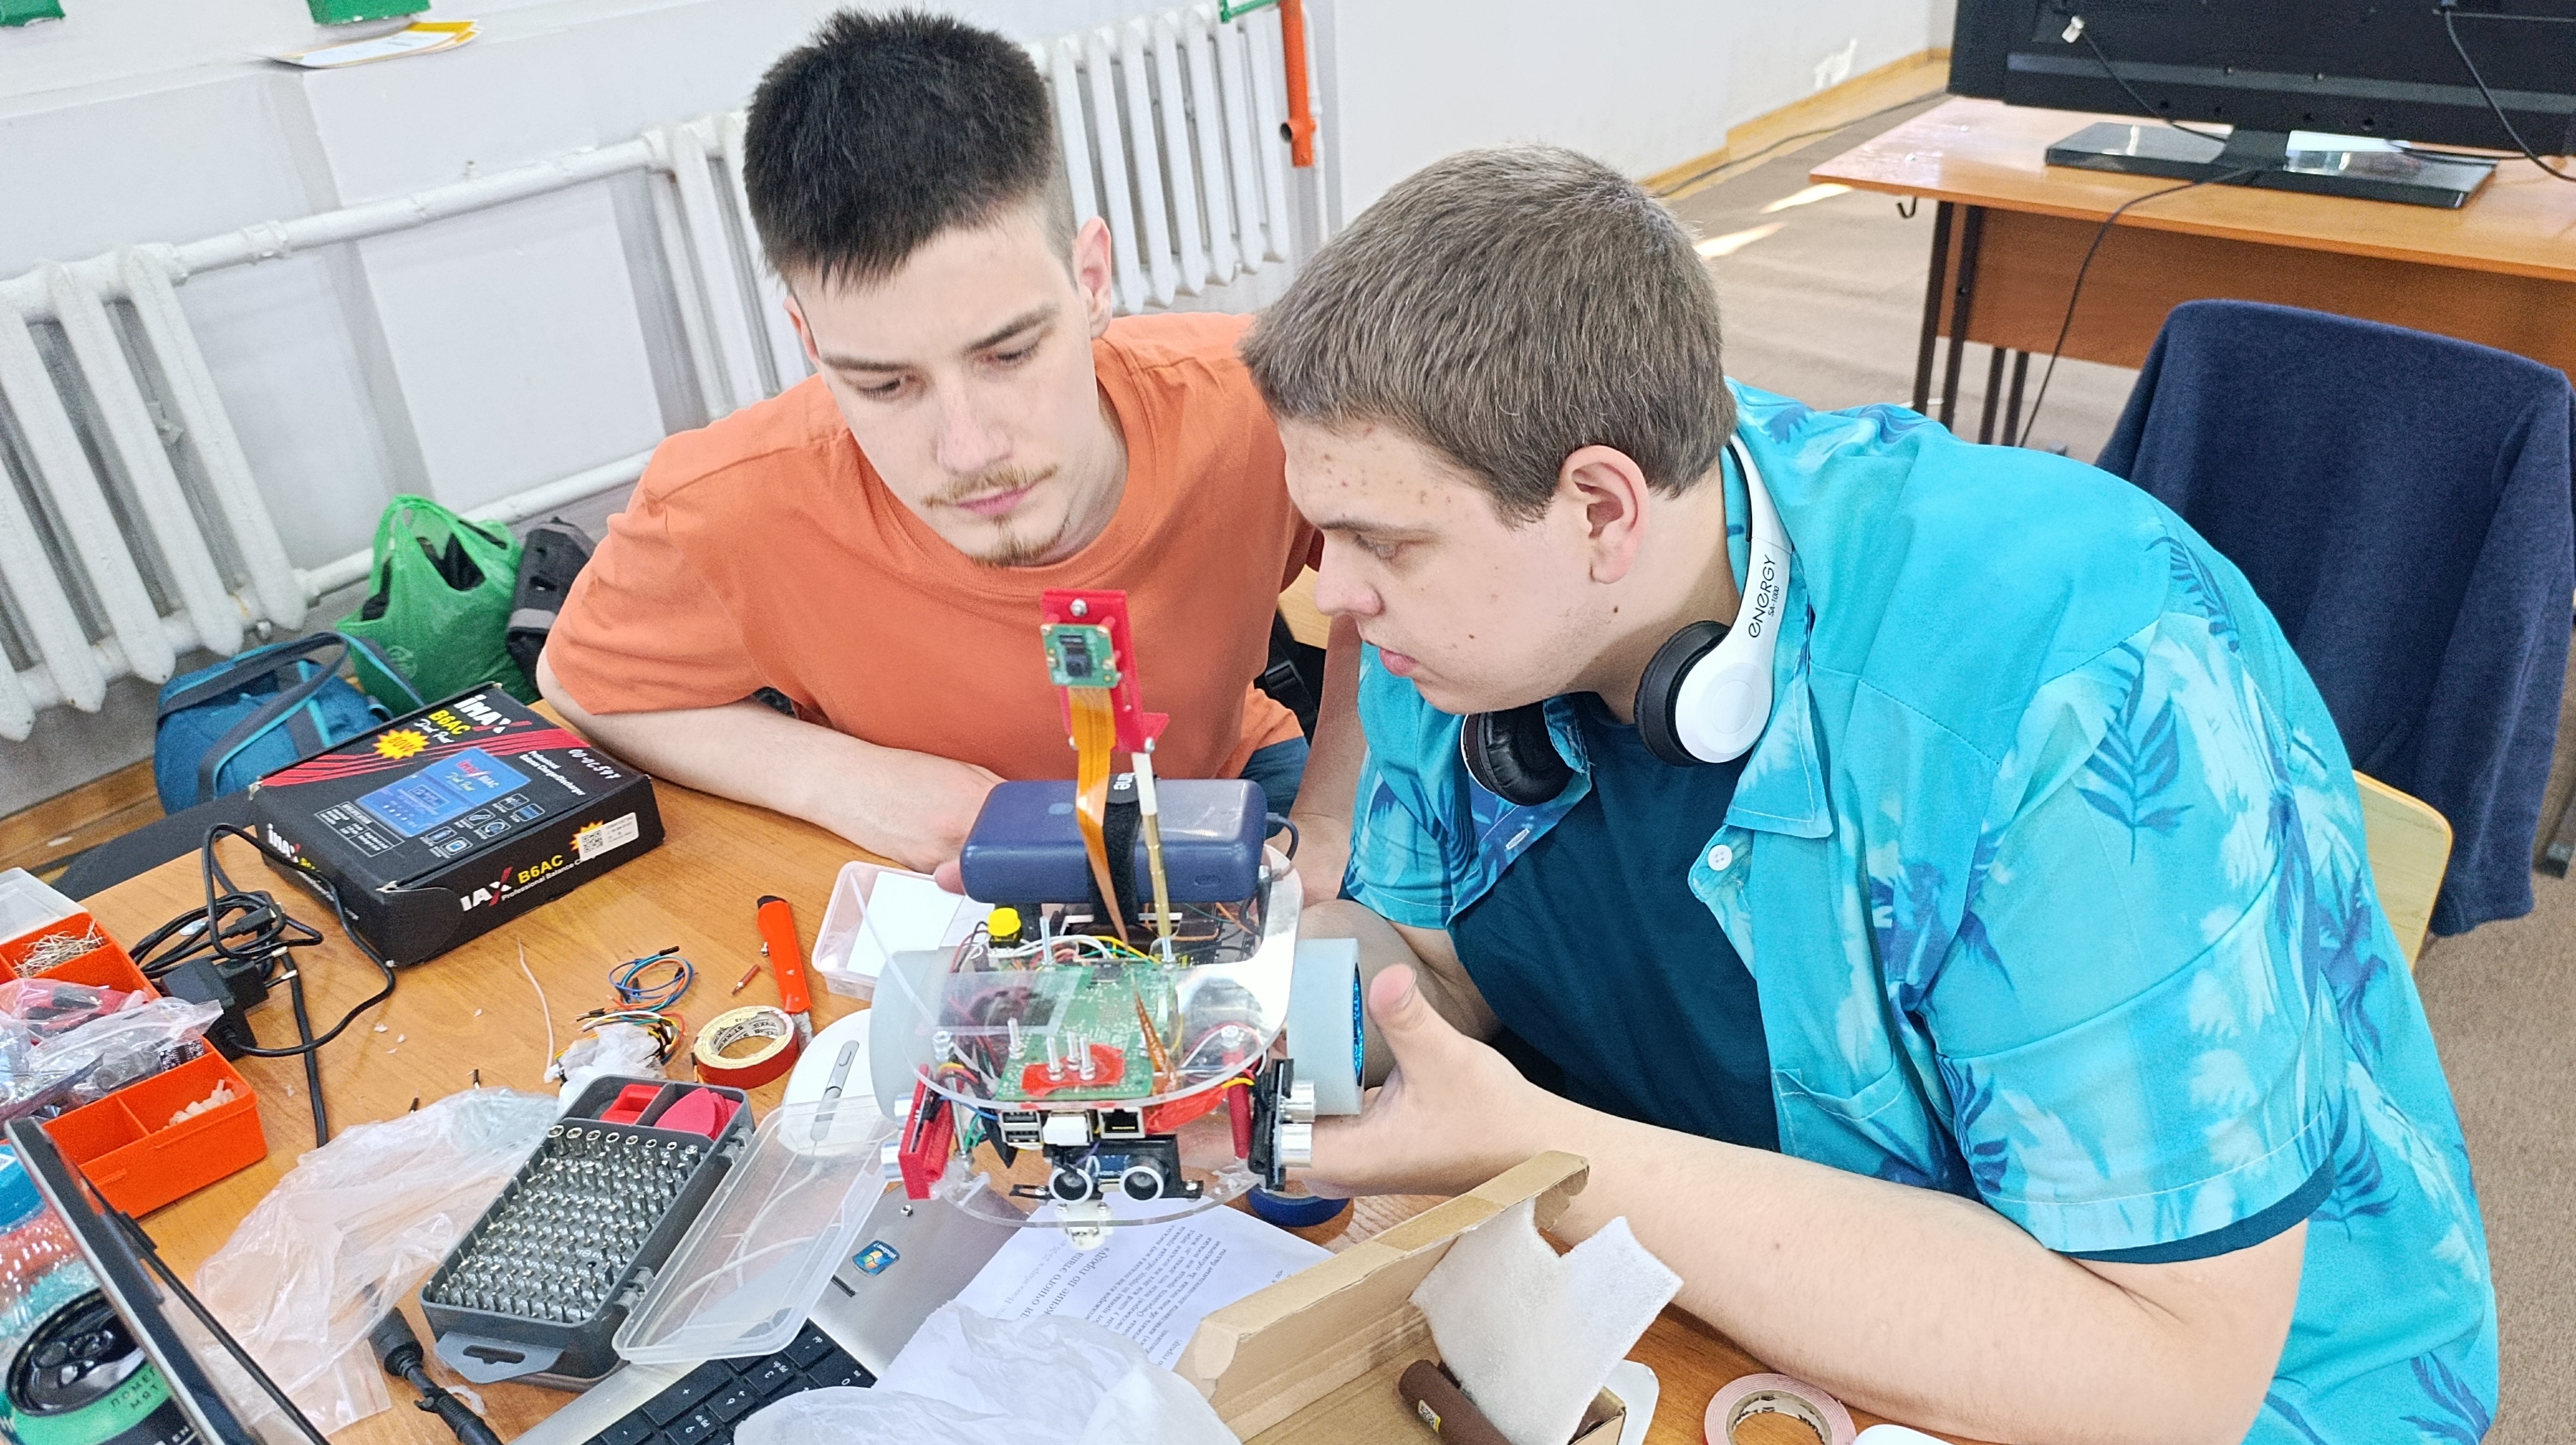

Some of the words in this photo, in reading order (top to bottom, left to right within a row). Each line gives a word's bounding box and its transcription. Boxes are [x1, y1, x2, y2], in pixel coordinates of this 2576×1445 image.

[1768, 585, 1780, 617] SA-1000
[429, 710, 470, 734] B6AC
[501, 876, 546, 901] Professional
[545, 861, 575, 880] Balance
[518, 854, 563, 884] B6AC
[877, 1244, 897, 1259] Windows
[1068, 1275, 1080, 1287] по
[1080, 1245, 1111, 1278] городу»
[1020, 1307, 1032, 1319] ля
[1031, 1273, 1062, 1305] очного
[1060, 1250, 1083, 1274] этапа
[765, 1370, 774, 1379] 3
[727, 1398, 735, 1406] 6
[685, 1425, 695, 1433] 9
